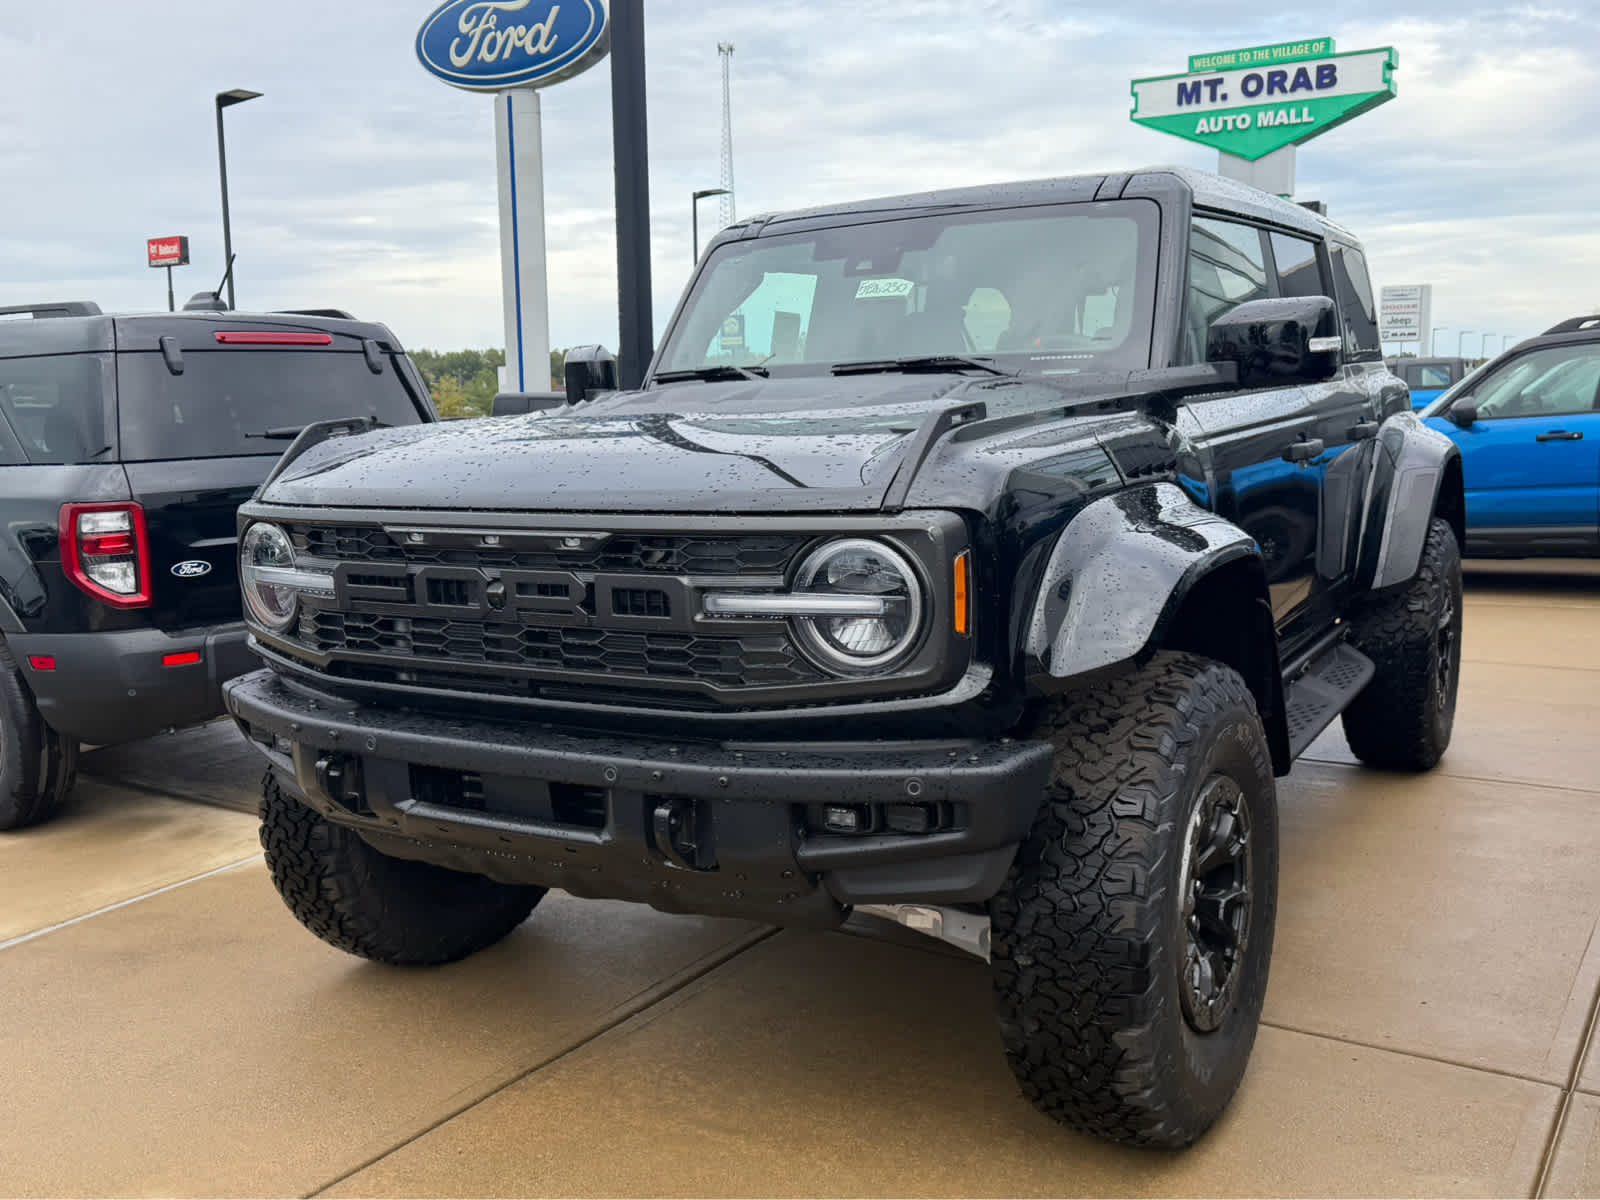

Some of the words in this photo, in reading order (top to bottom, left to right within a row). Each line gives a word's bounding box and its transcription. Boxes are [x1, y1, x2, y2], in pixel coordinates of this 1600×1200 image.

[450, 0, 560, 67] Ford
[1193, 54, 1236, 69] WELCOME
[1239, 52, 1250, 63] TO
[1253, 49, 1270, 61] THE
[1272, 43, 1309, 58] VILLAGE
[1312, 41, 1325, 53] OF
[1177, 77, 1228, 107] MT.
[1241, 63, 1338, 98] ORAB
[1195, 113, 1250, 135] AUTO
[1257, 107, 1315, 128] MALL
[1387, 316, 1412, 327] Jeep
[179, 563, 204, 575] Ford
[334, 561, 692, 632] FORD
